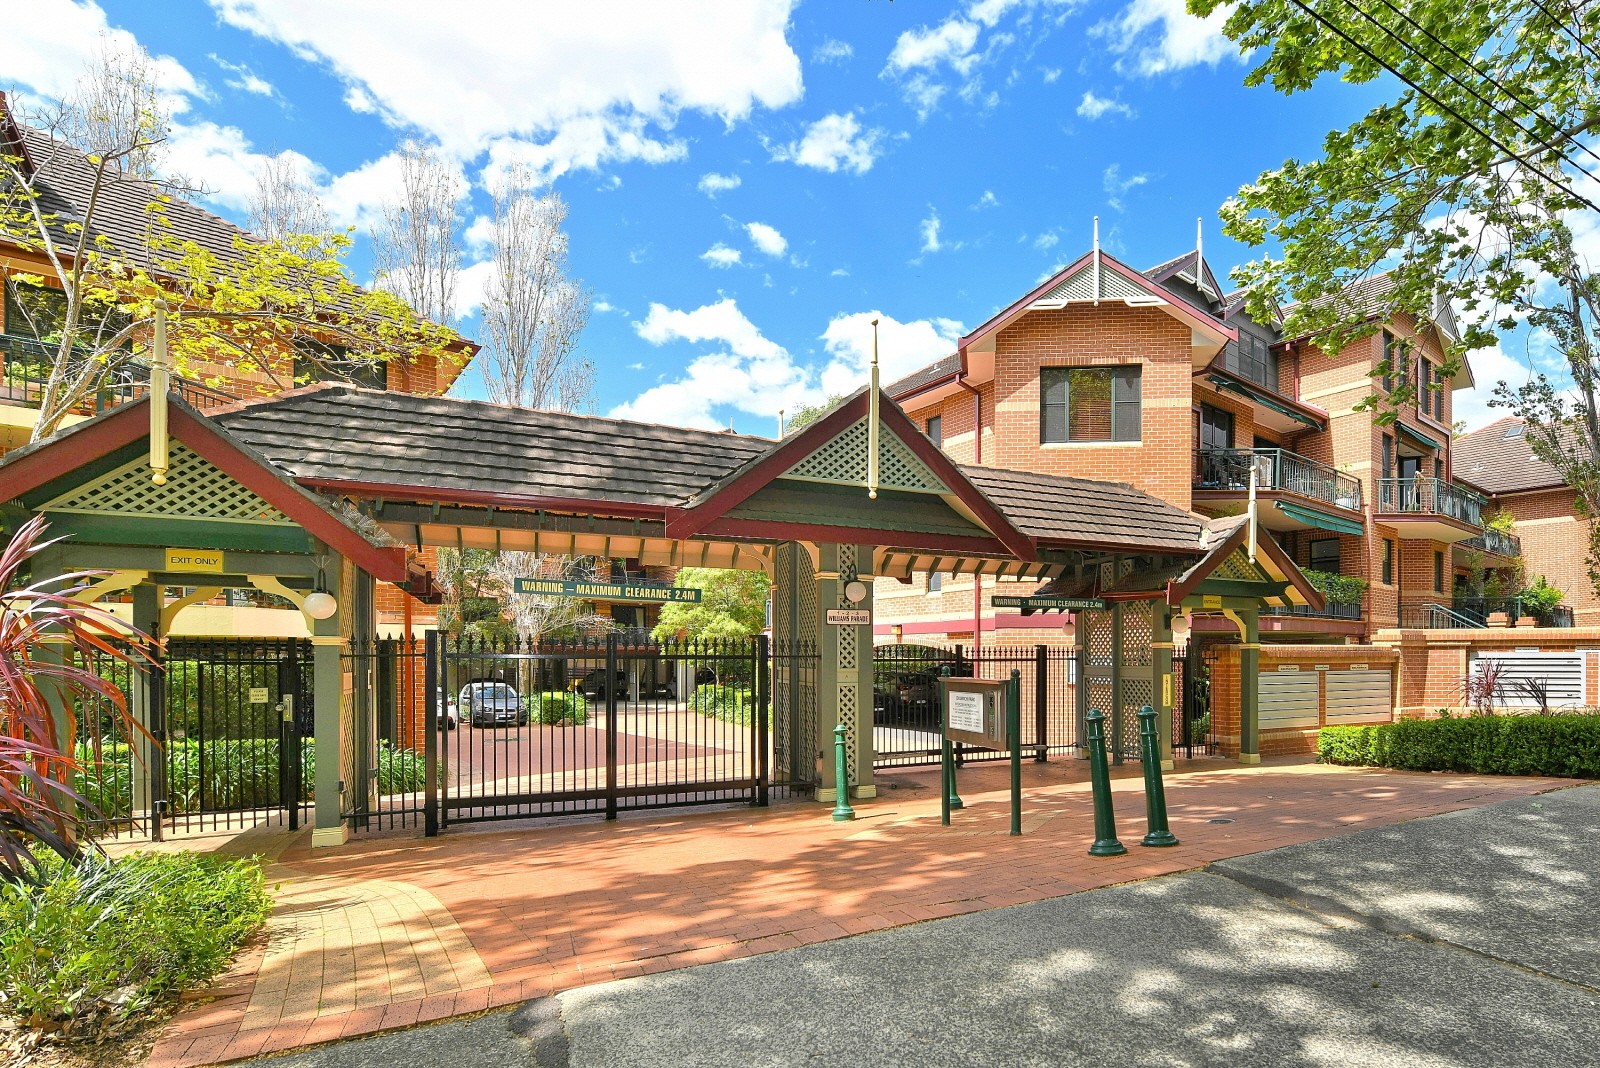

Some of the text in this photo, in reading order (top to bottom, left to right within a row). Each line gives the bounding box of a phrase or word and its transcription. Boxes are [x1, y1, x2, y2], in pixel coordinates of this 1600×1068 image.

[521, 580, 564, 593] WARNING
[576, 584, 621, 597] MAXIMUM
[625, 587, 672, 599] CLEARANCE
[674, 589, 696, 601] 2.4M
[994, 598, 1021, 606] WARNING
[1028, 599, 1057, 607] MAXIMUM
[1057, 599, 1089, 608] CLEARANCE
